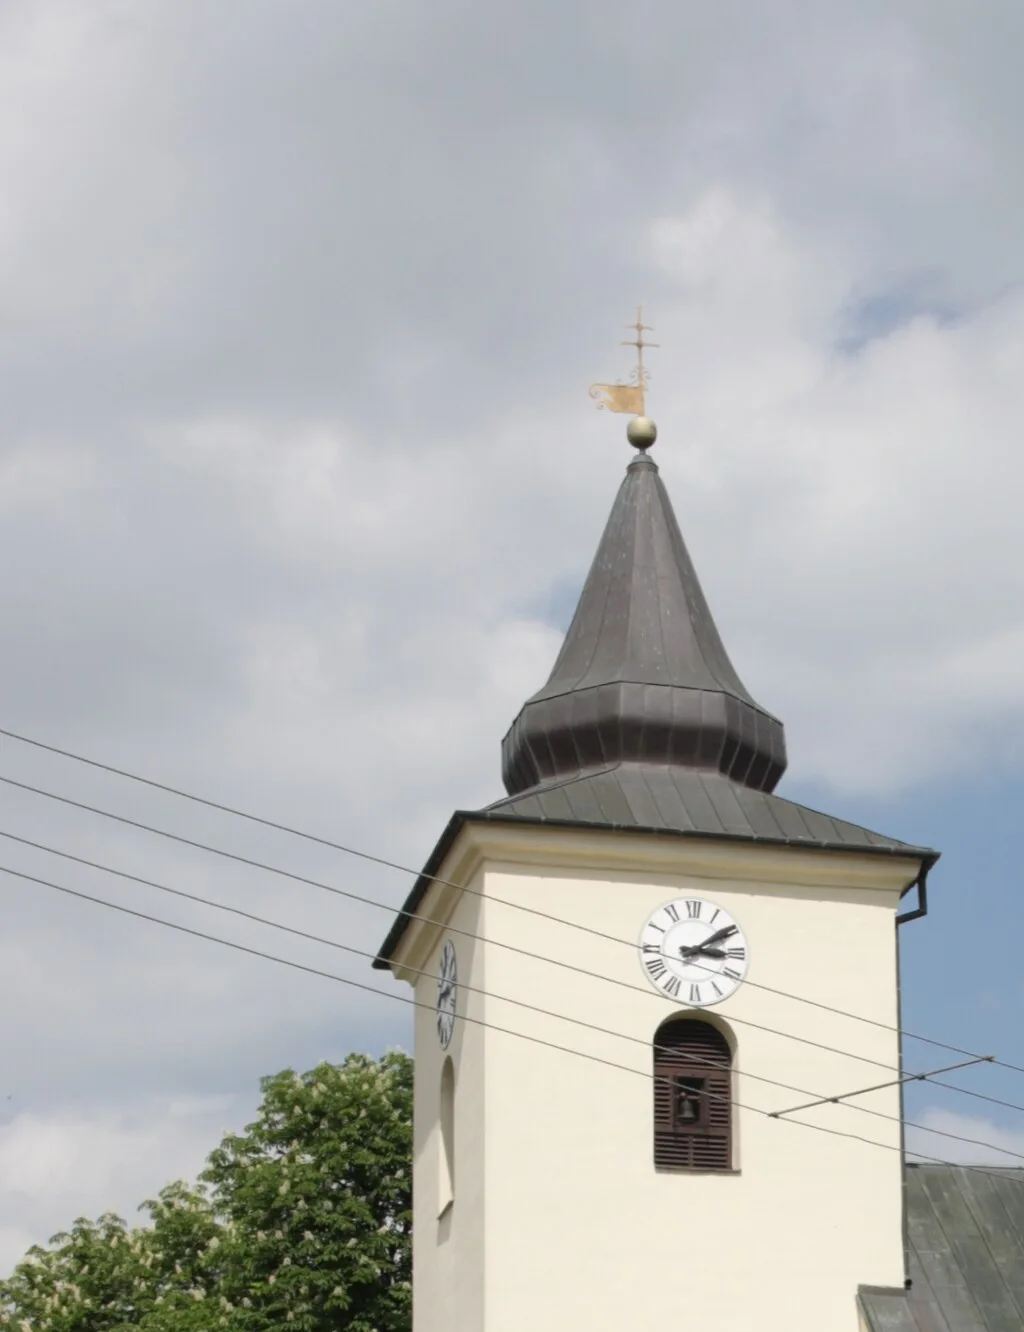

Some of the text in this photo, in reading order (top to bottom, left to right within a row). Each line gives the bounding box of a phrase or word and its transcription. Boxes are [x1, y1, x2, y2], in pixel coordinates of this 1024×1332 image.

[663, 903, 680, 923] XI
[685, 900, 702, 919] XII
[709, 907, 720, 924] I
[727, 947, 745, 960] III
[645, 958, 668, 981] VIII
[663, 975, 682, 997] VII
